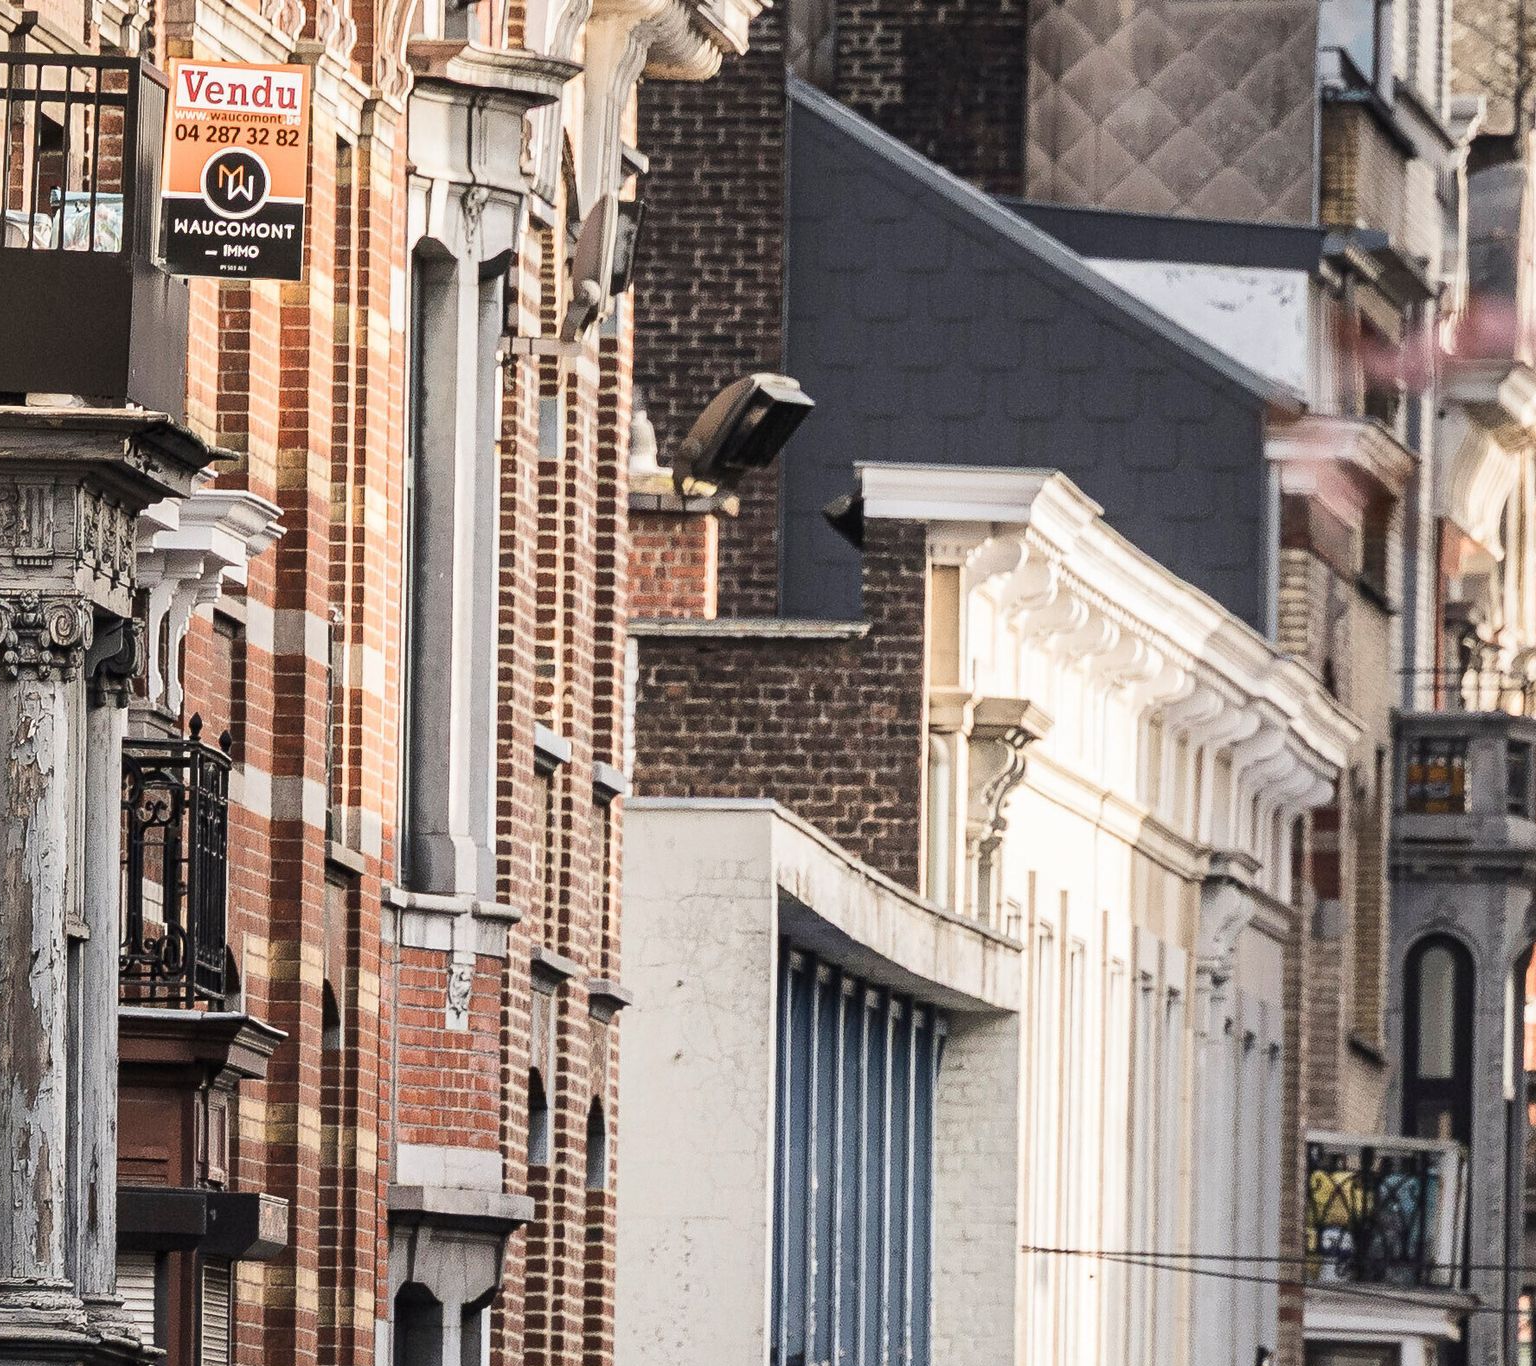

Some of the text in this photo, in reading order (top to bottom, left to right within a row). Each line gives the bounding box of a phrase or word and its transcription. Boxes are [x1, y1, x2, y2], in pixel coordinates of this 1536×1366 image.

[182, 70, 297, 109] Vendu
[175, 110, 301, 126] www.waucomont.be
[175, 124, 299, 146] 04 287 32 82
[174, 218, 295, 239] WAUCOMONT
[223, 244, 260, 258] IMMO
